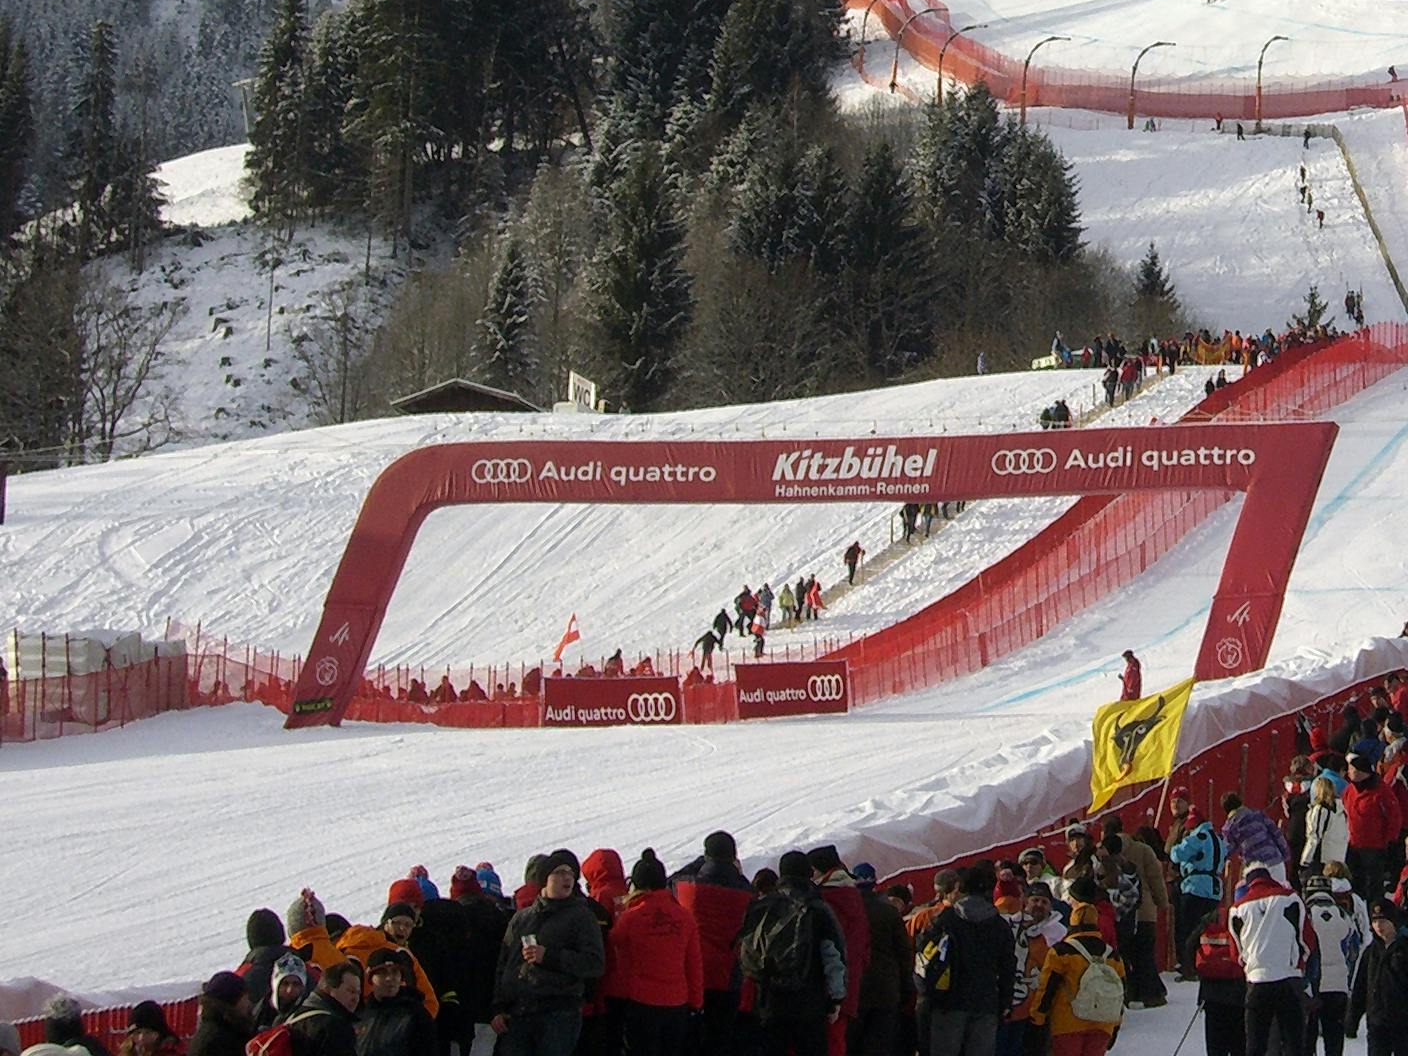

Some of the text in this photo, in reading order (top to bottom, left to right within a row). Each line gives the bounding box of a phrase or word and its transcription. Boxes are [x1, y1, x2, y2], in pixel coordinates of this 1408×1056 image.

[573, 384, 591, 407] WC
[771, 444, 938, 481] Kitzbühel
[1063, 446, 1256, 471] Audi quattro
[538, 460, 717, 487] Audi quattro
[775, 481, 930, 497] Hahnenkamm-Rennen
[739, 688, 807, 704] Audi quattro
[545, 705, 627, 724] Audi quattro
